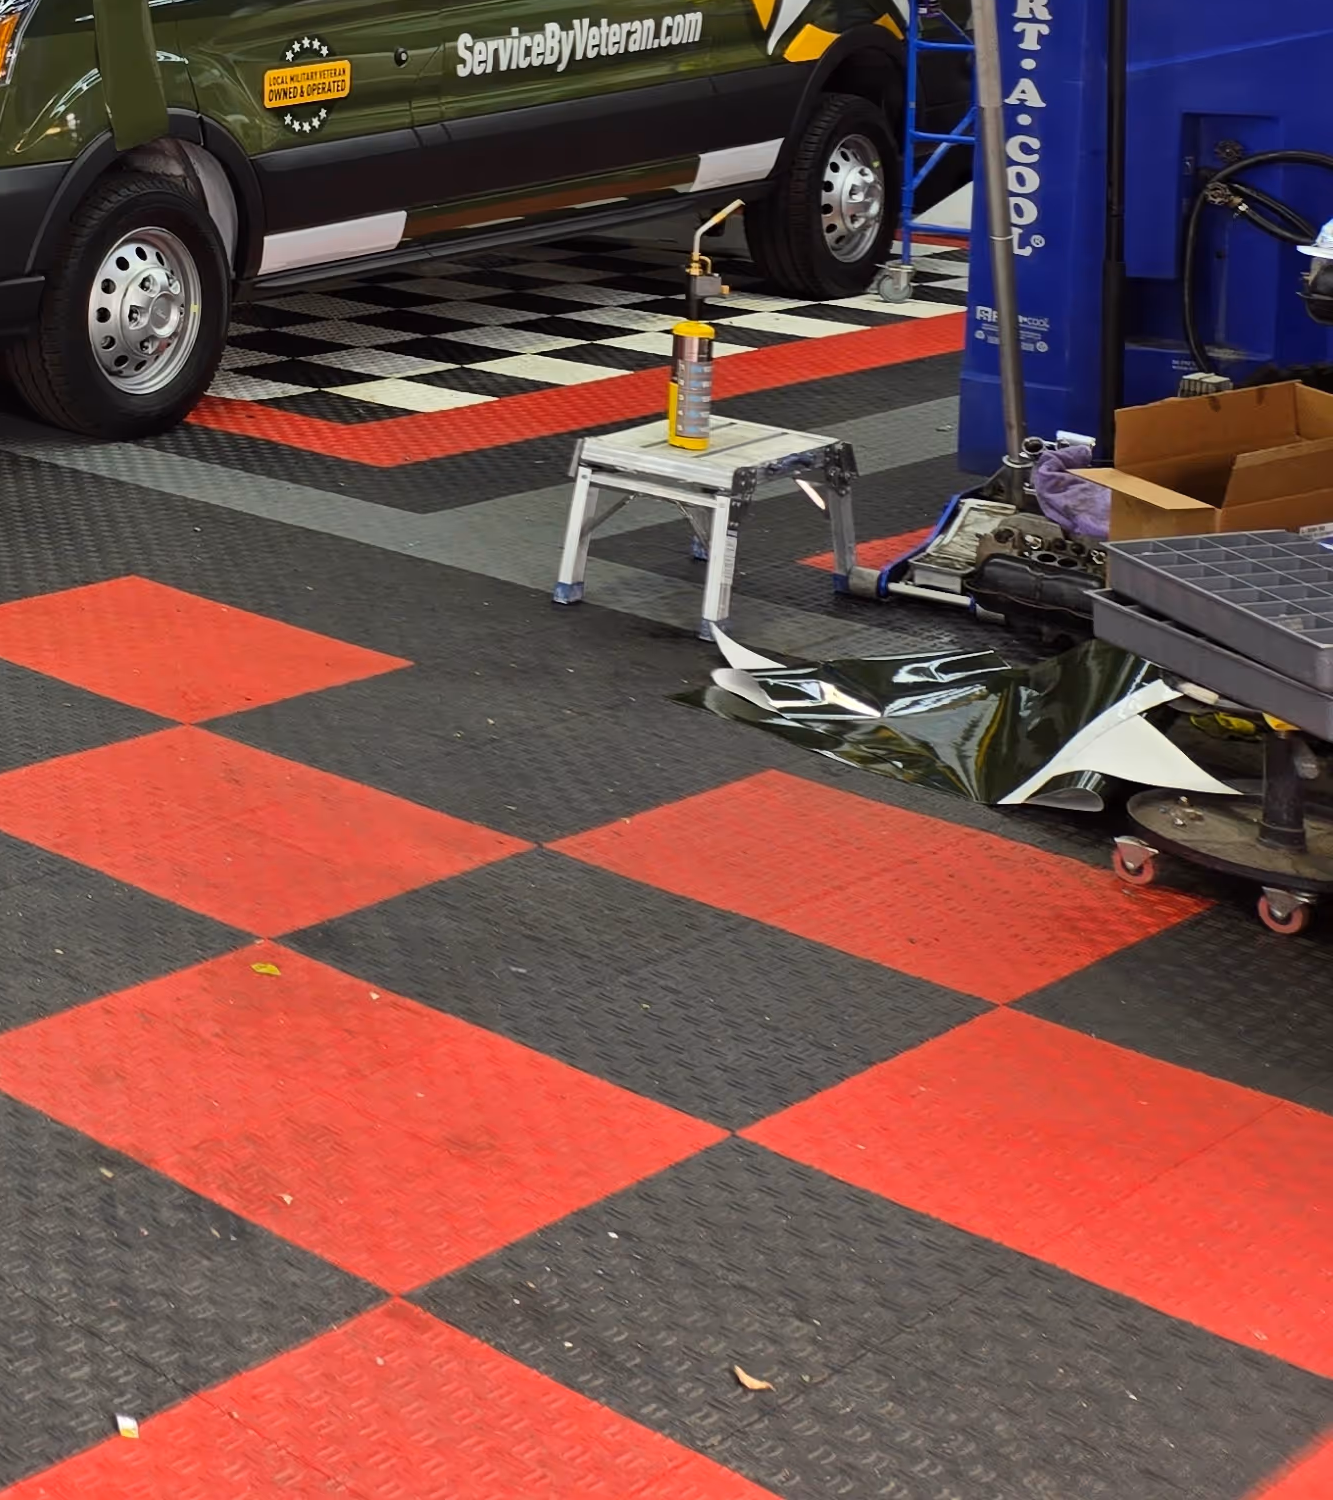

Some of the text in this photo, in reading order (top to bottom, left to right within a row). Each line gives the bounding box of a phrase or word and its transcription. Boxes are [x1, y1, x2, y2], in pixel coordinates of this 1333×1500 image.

[456, 11, 703, 78] ServiceByVeteran.com
[269, 67, 346, 87] LOCAL MILITARY VETERAN
[269, 79, 346, 102] OWNED & OPERATED
